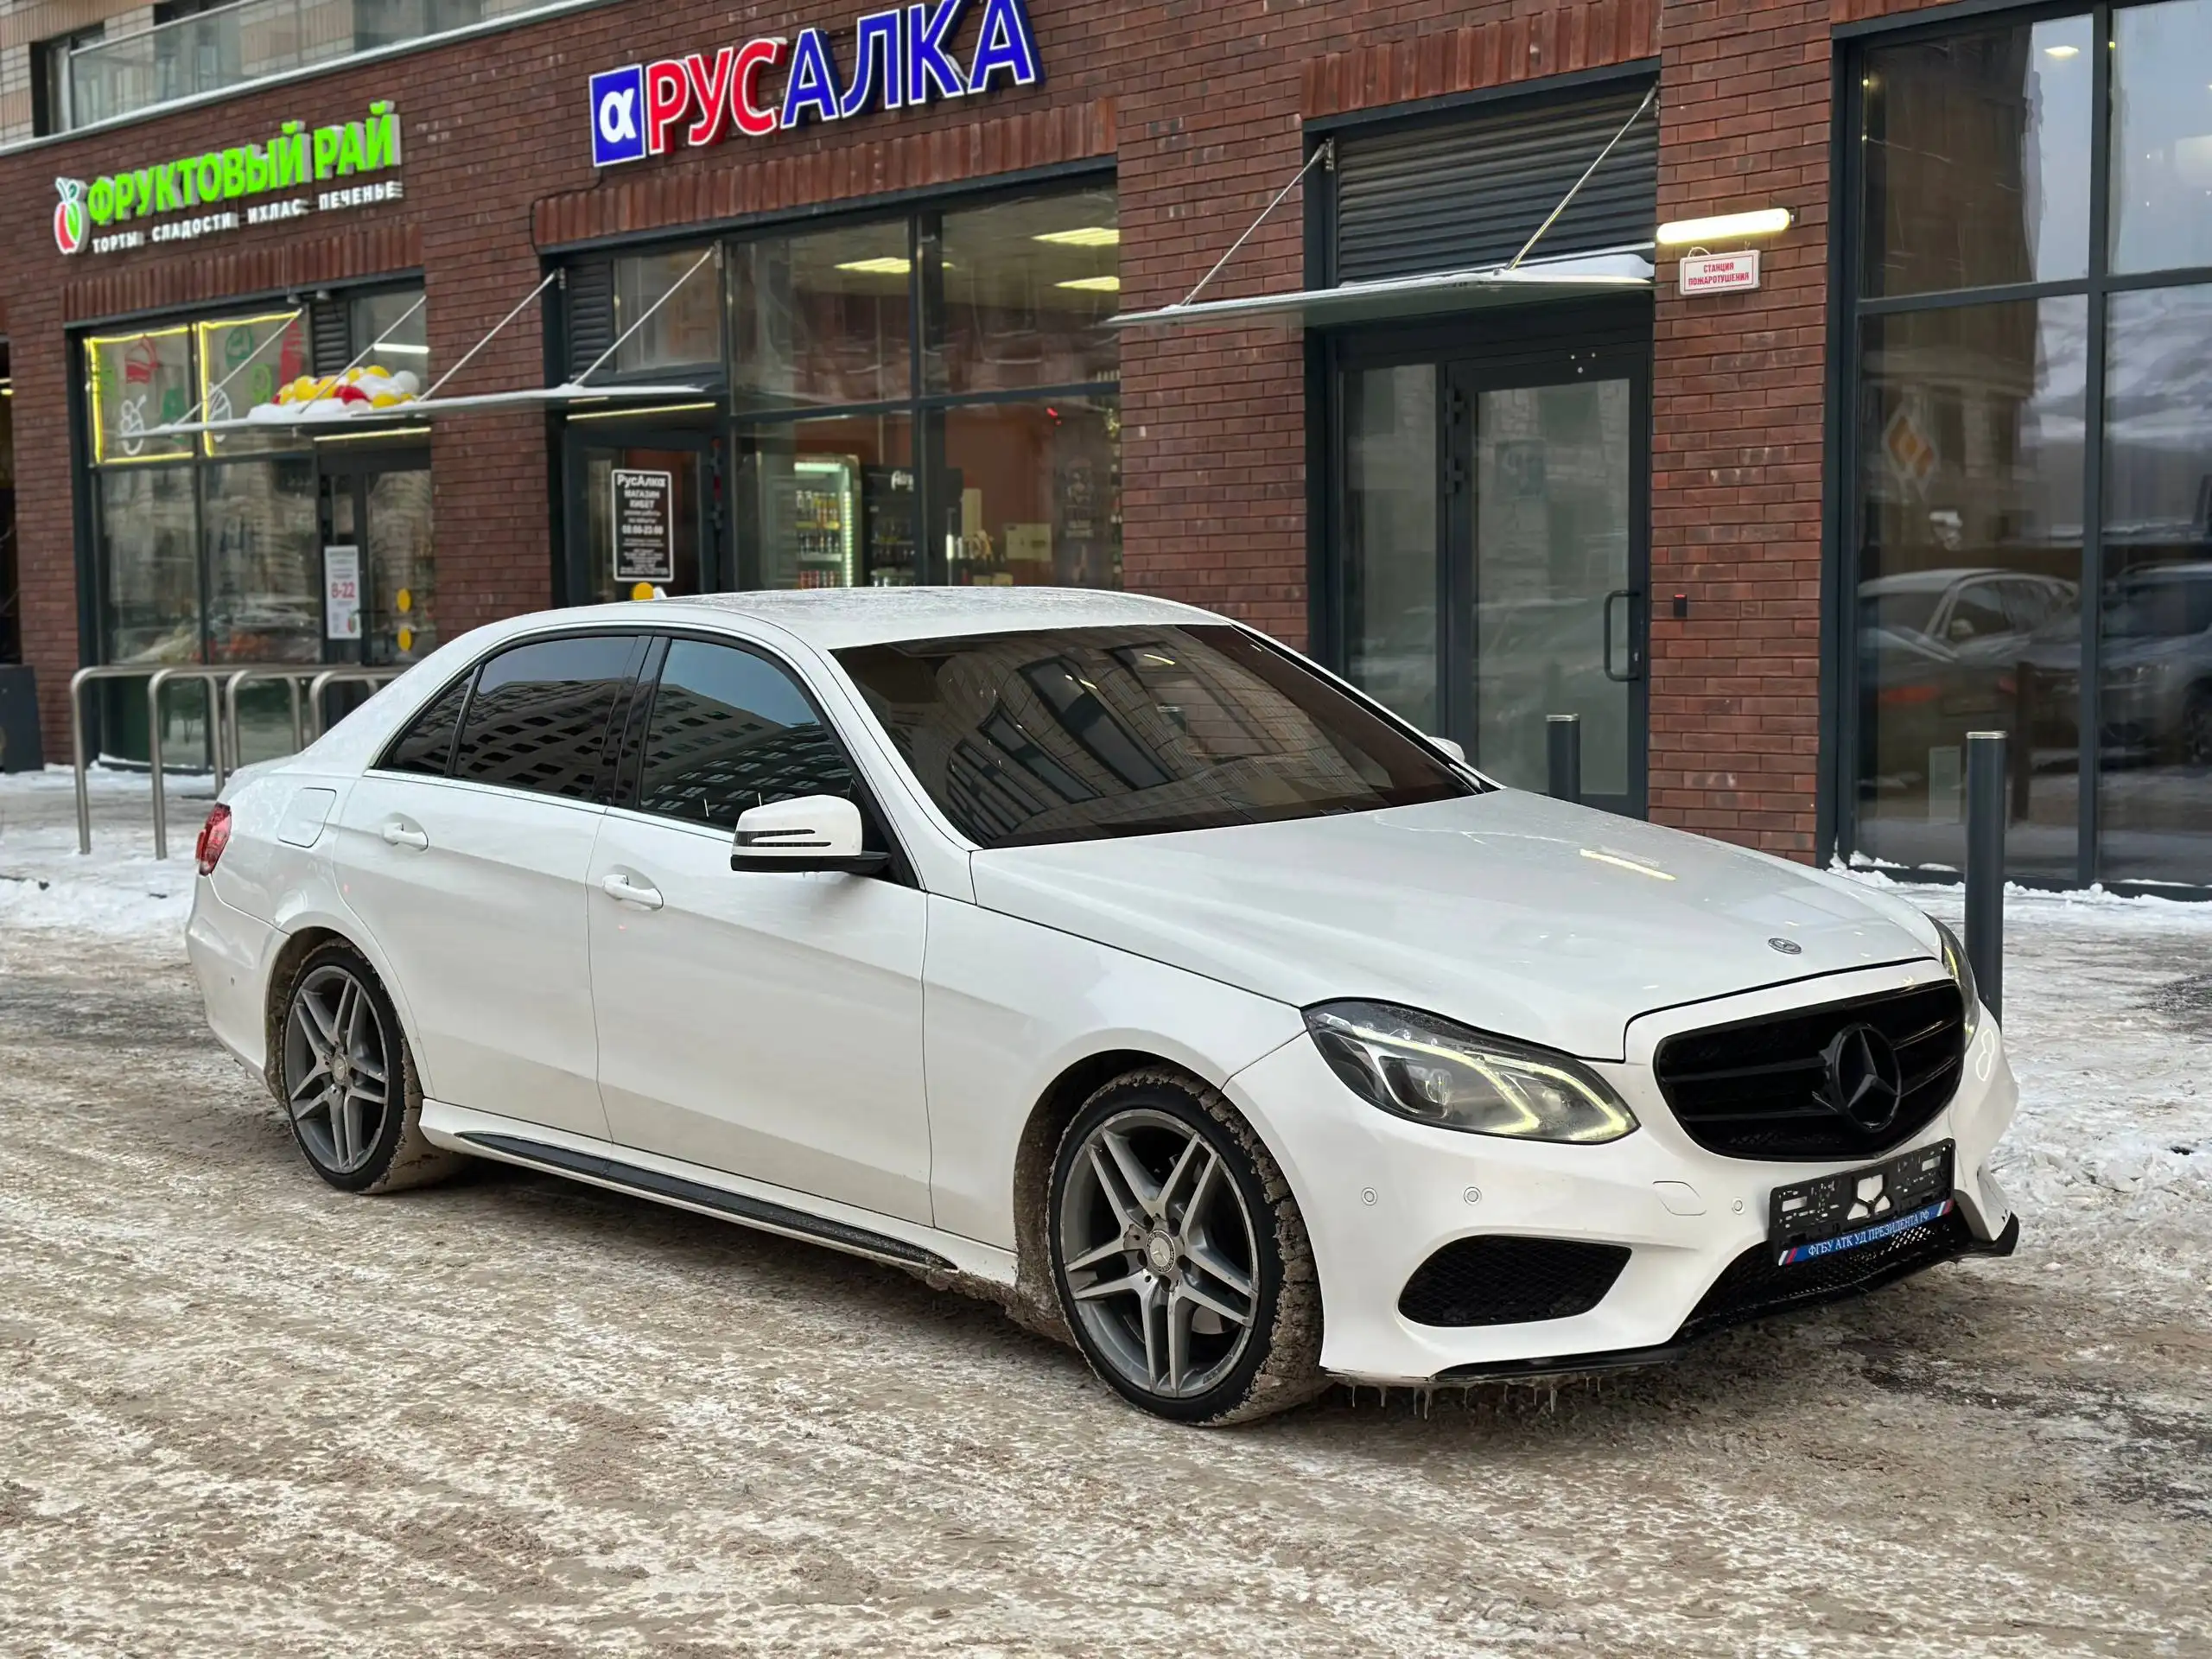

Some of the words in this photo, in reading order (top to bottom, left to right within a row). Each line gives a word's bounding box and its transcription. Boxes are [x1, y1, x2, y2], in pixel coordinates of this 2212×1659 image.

[646, 0, 1040, 156] РУСАЛКА
[88, 120, 311, 226] ФРУКТОВЫЙ
[314, 100, 400, 181] РАЙ
[92, 232, 142, 254] ТОРТЫ
[151, 212, 237, 243] СЛАДОСТИ
[247, 199, 307, 224] ИХЛАС
[318, 181, 401, 211] ПЕЧЕНЬЕ
[1688, 272, 1750, 286] ПОЖАРОТУШЕНИЯ
[1703, 262, 1735, 273] СТАНЦИЯ
[624, 489, 660, 499] МАГАЗИН
[1808, 1239, 1834, 1256] ФГБУ
[1835, 1236, 1853, 1250] АТК
[1854, 1233, 1867, 1244] УД
[1868, 1215, 1919, 1241] ПРЕЗИДЕНТА
[1919, 1210, 1930, 1225] РФ
